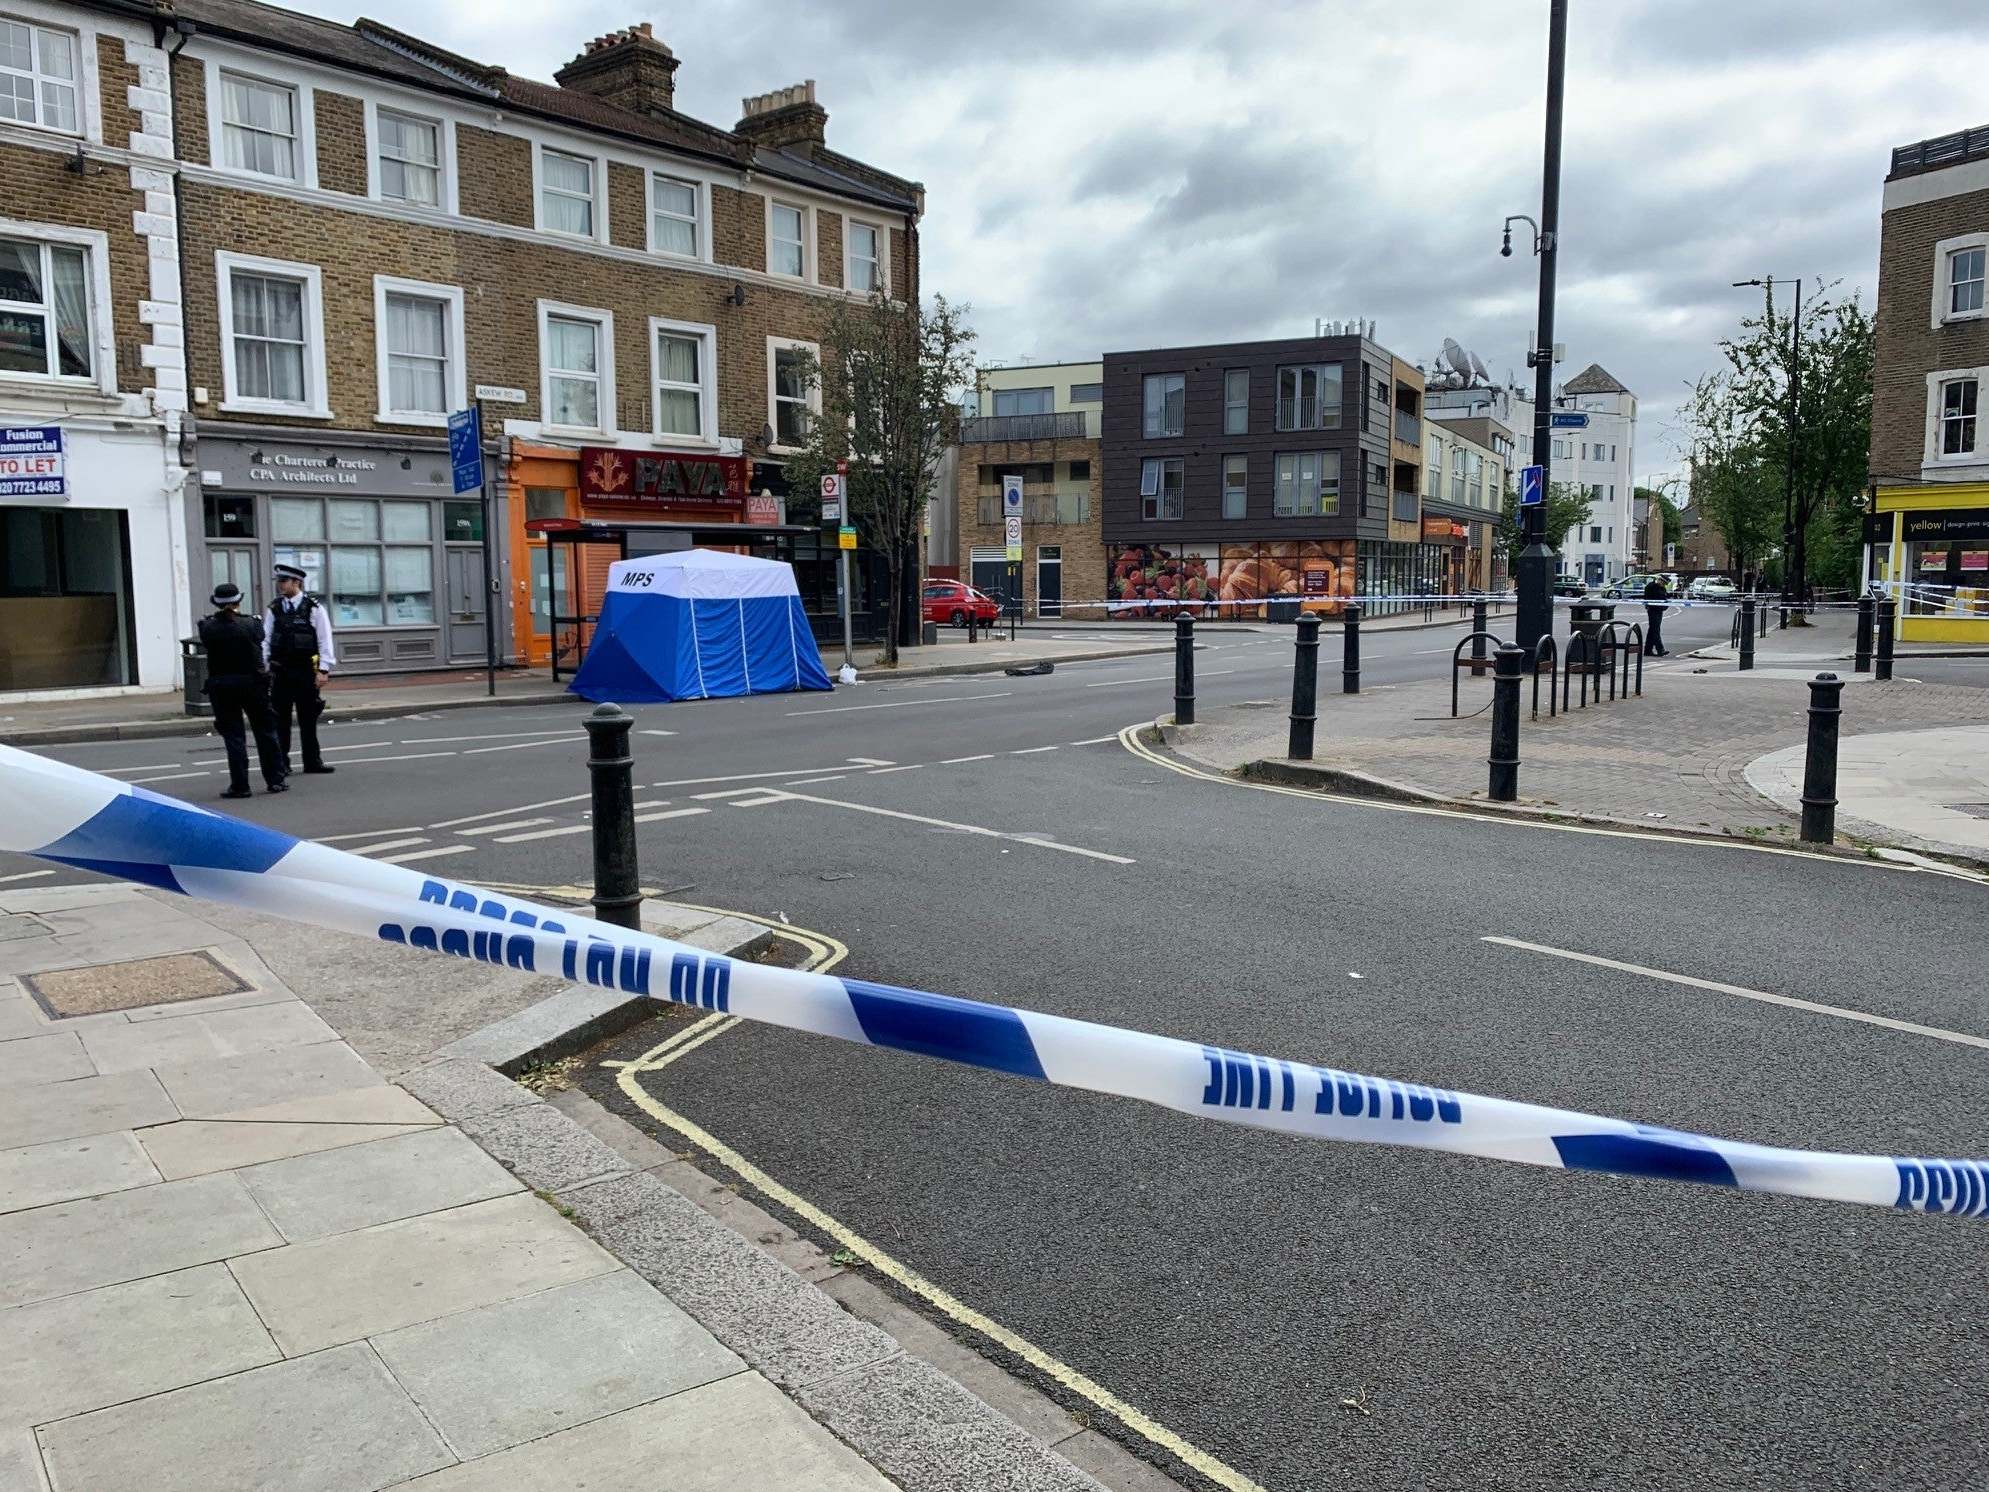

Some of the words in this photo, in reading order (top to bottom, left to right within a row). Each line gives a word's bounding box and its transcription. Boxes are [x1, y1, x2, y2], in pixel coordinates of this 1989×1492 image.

[6, 429, 44, 440] Fusion
[0, 460, 18, 473] TO
[25, 459, 56, 473] LET
[250, 469, 275, 480] CPA
[280, 470, 335, 482] Architects
[338, 472, 357, 484] Ltd
[634, 457, 726, 496] PAYA
[0, 482, 13, 494] 20
[37, 480, 61, 492] 4495
[749, 497, 777, 512] PAYA
[1009, 524, 1019, 533] 20
[1911, 520, 1941, 532] yellow
[621, 572, 655, 587] MPS
